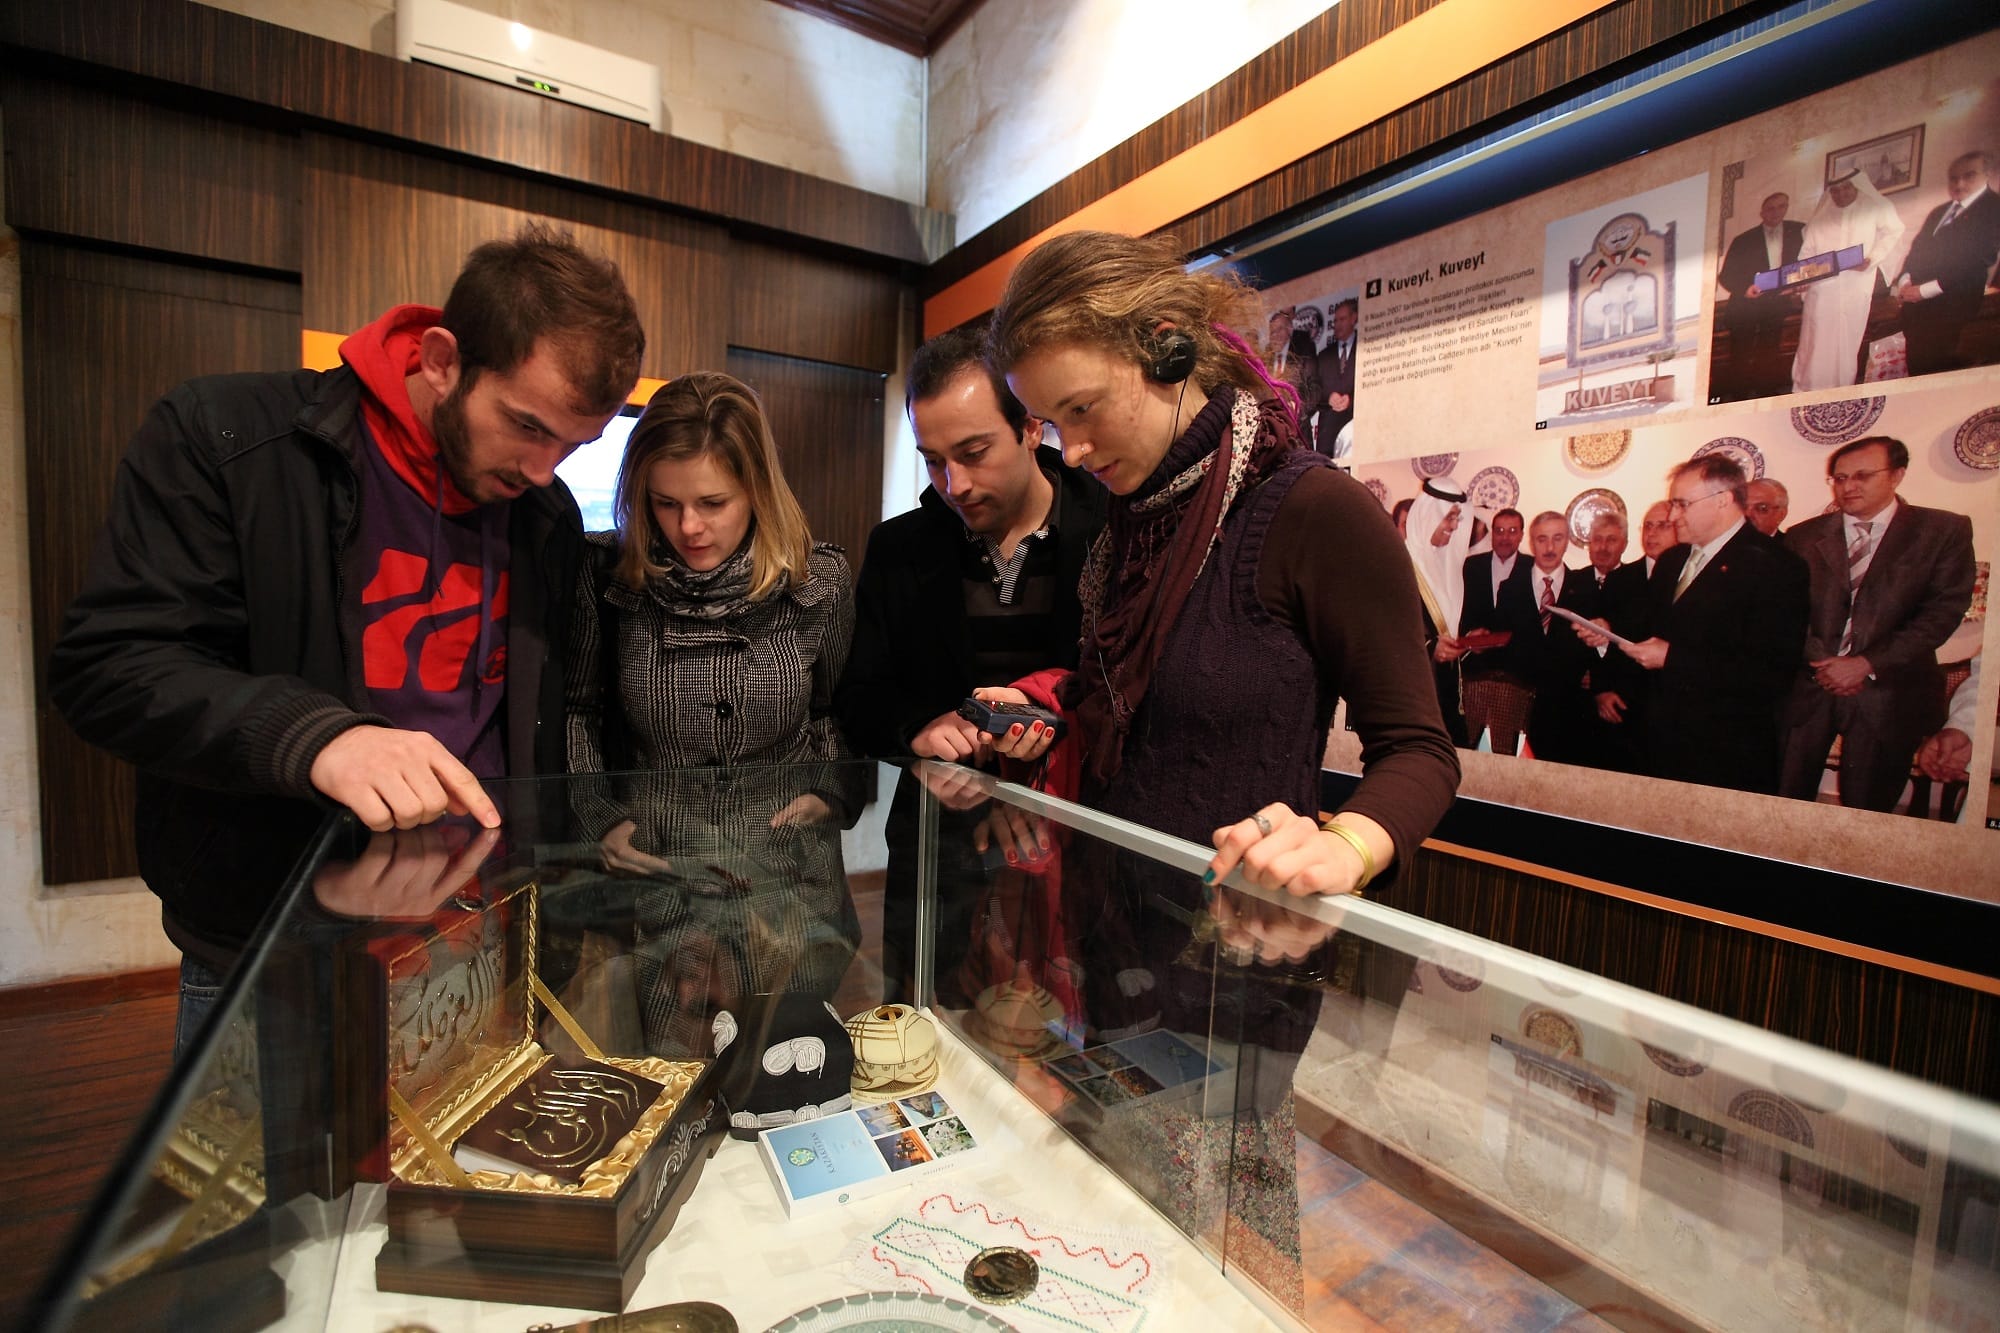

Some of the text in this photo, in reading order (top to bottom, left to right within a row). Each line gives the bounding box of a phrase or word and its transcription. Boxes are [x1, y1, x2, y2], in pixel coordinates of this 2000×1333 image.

[1388, 268, 1434, 293] Kuveyt,
[1439, 251, 1486, 278] Kuveyt
[1565, 379, 1656, 411] KUVEYT
